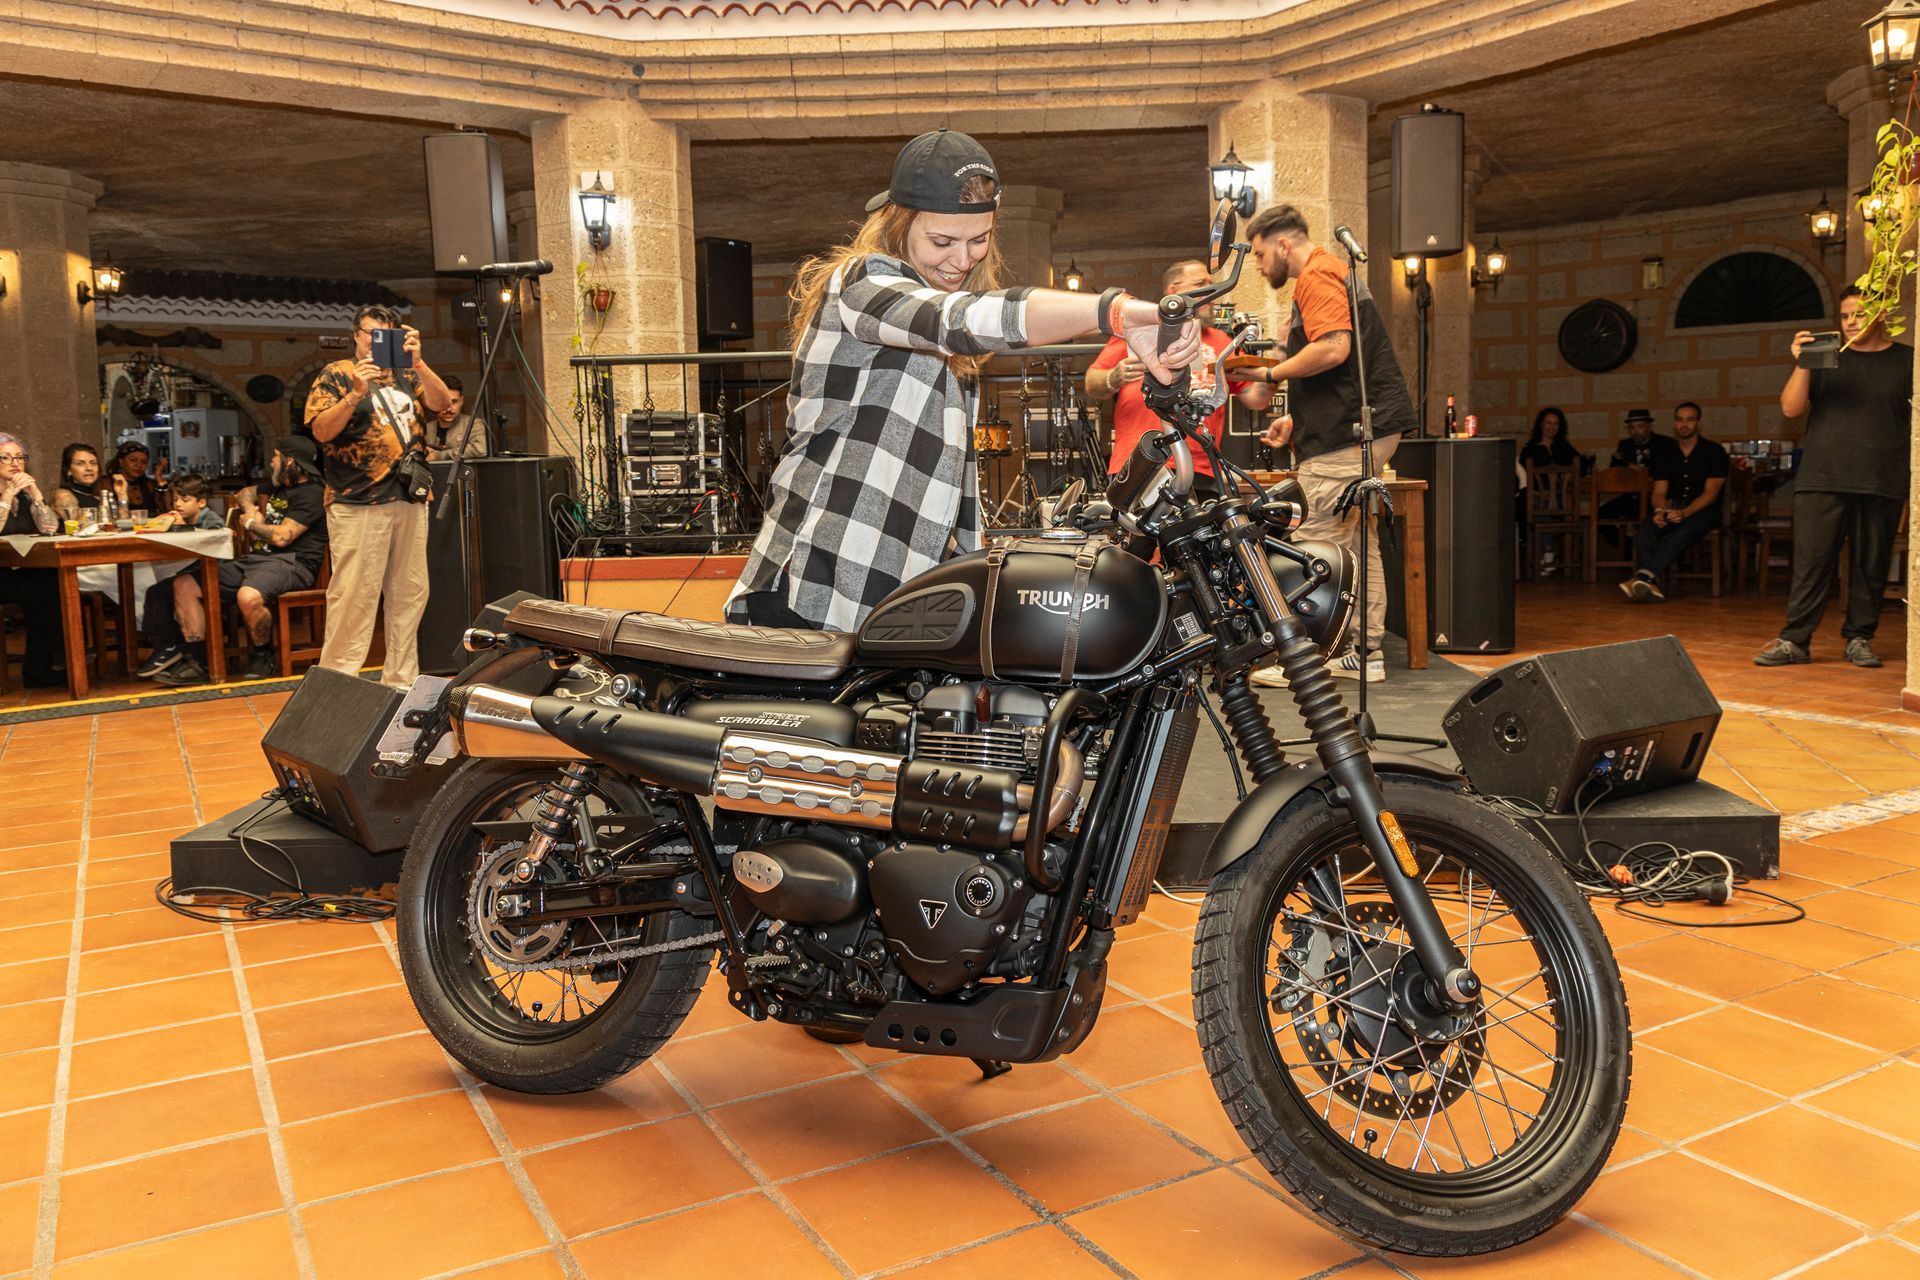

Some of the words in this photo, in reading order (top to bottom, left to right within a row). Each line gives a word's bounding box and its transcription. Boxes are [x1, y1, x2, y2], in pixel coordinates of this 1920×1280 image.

[954, 166, 968, 177] FOR
[758, 711, 811, 721] STREET
[716, 716, 802, 728] SCRAMBLER
